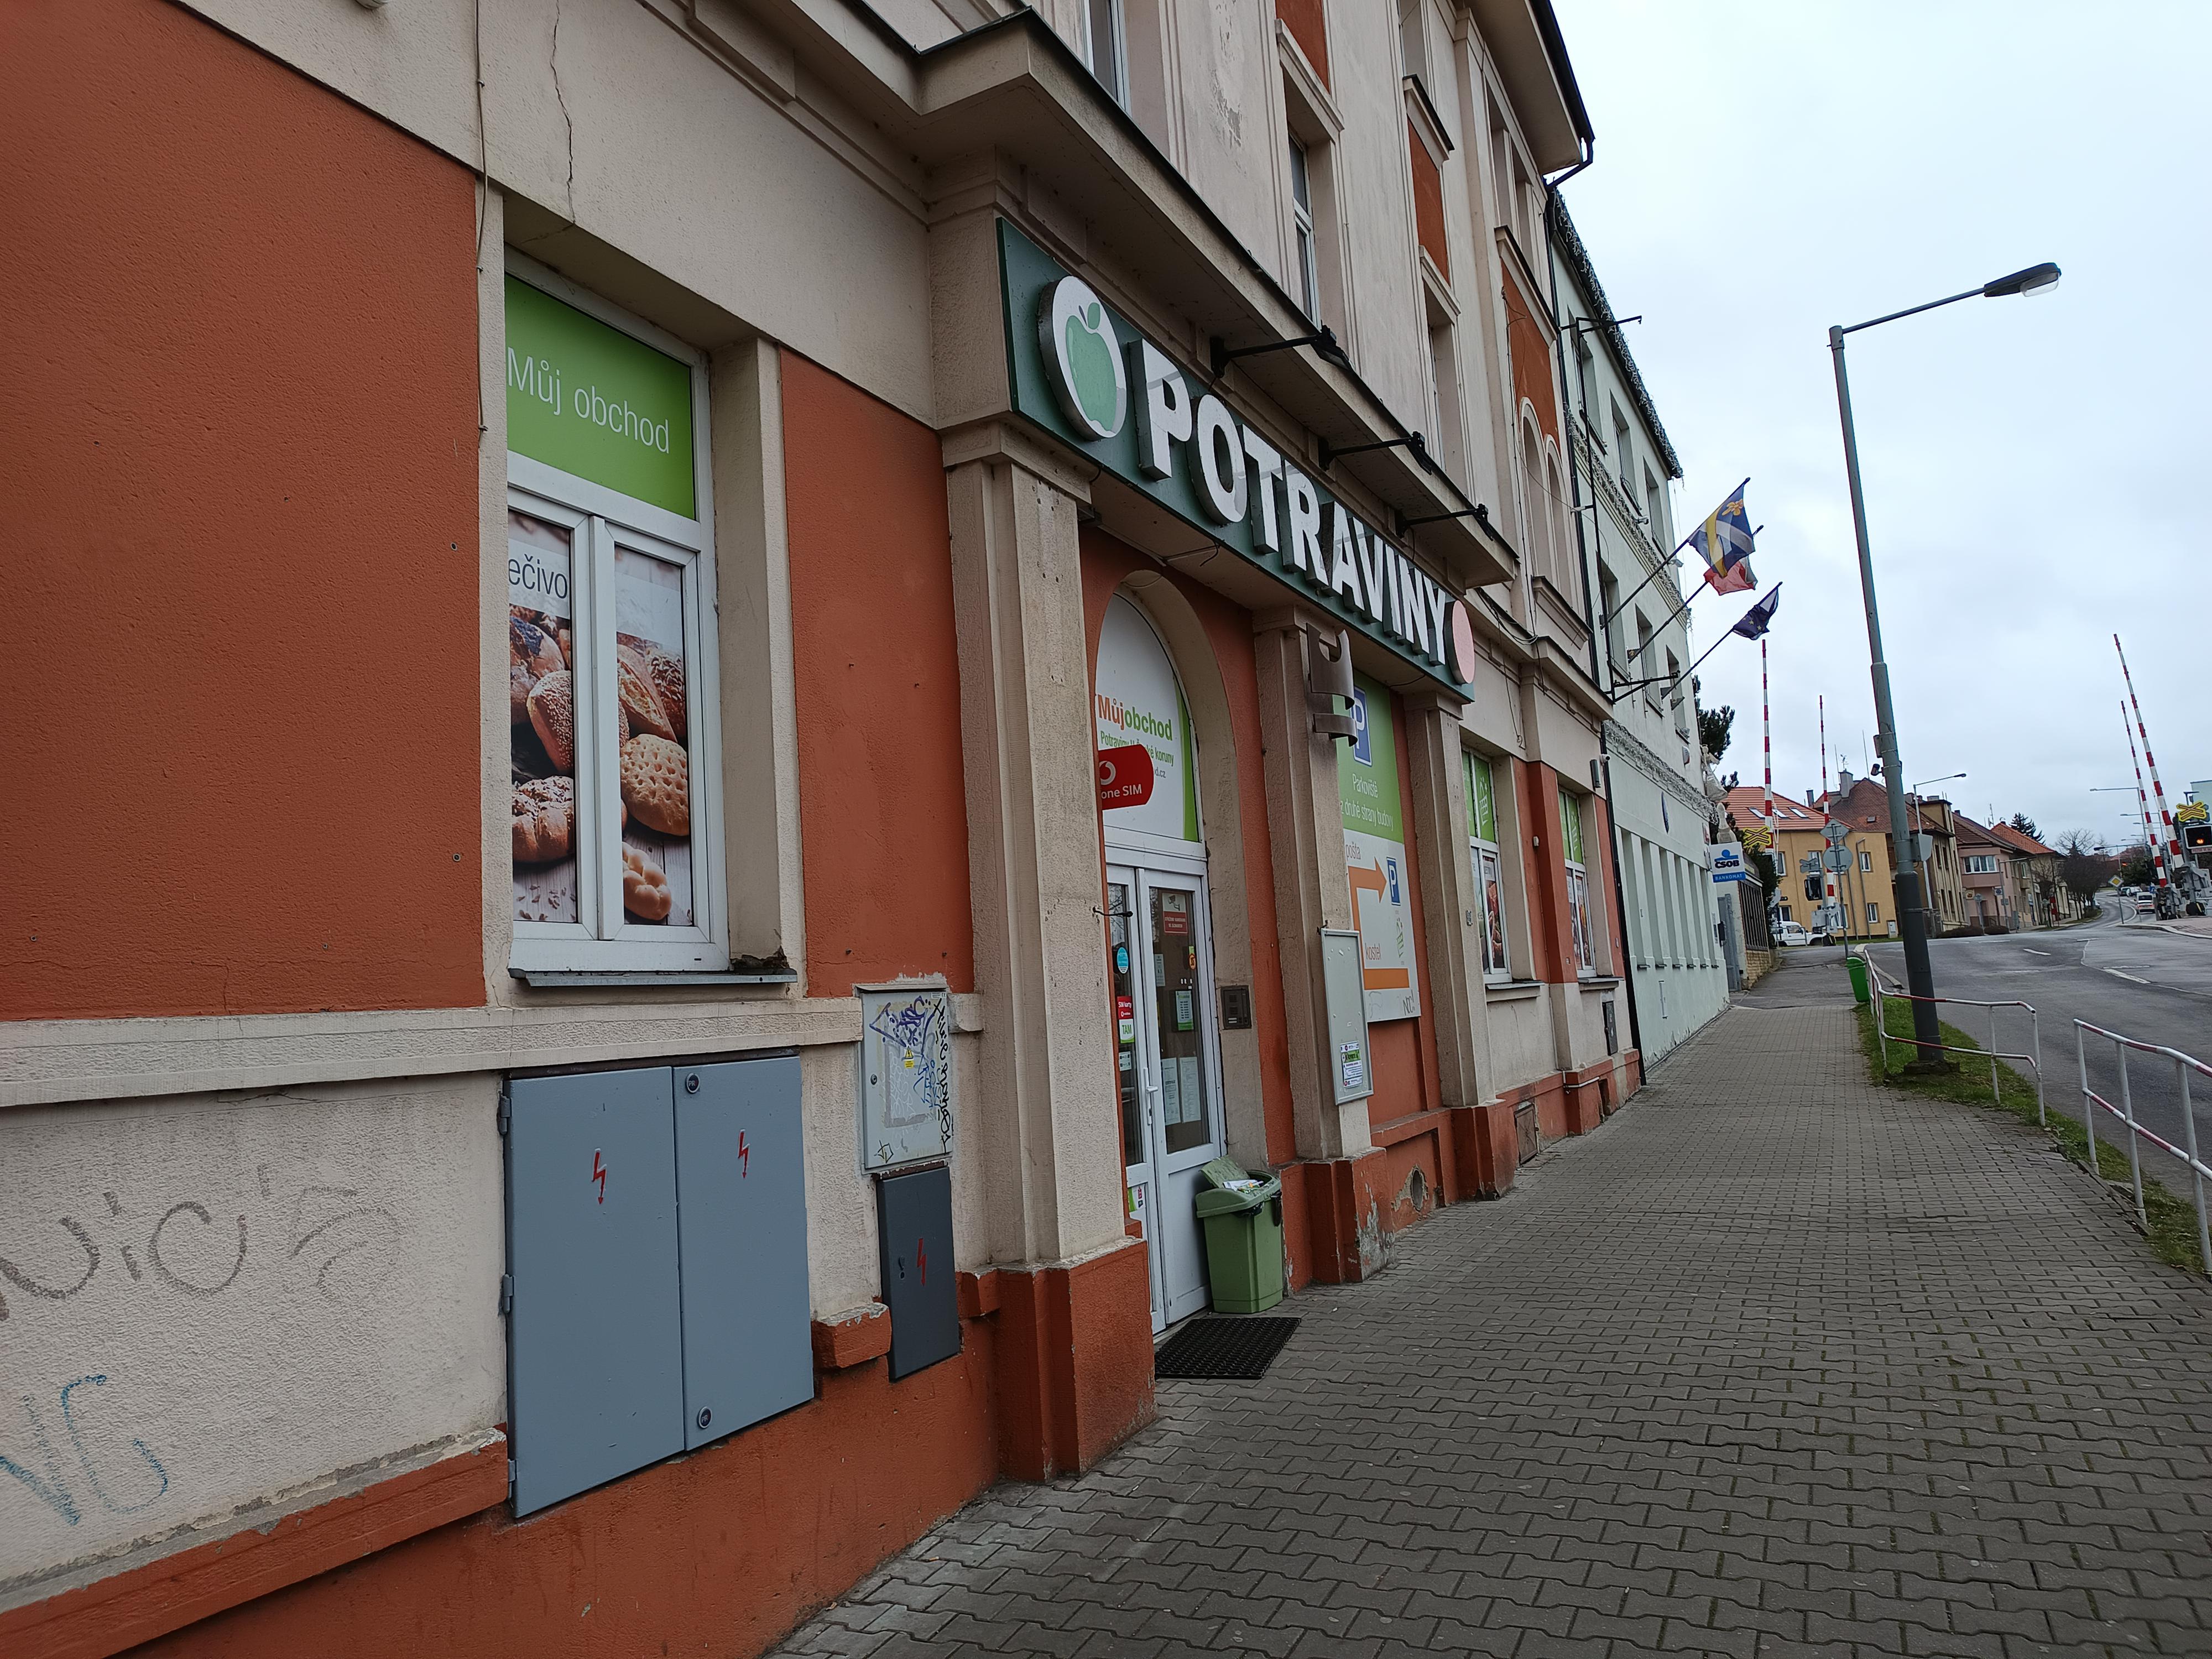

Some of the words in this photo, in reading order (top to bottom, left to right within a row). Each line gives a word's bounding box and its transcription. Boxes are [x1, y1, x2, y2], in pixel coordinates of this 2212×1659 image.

[507, 346, 561, 416] Můj
[574, 385, 670, 455] obchod
[1129, 338, 1447, 665] POTRAVINY
[1155, 747, 1174, 767] koruny
[1122, 784, 1142, 797] SIM
[1352, 773, 1378, 799] Parkoviště
[1344, 798, 1360, 818] druhé
[1361, 804, 1376, 827] strany
[1376, 807, 1394, 832] budovy
[1345, 841, 1361, 862] pošta
[1364, 942, 1381, 960] kostel
[1122, 1024, 1132, 1034] TAM
